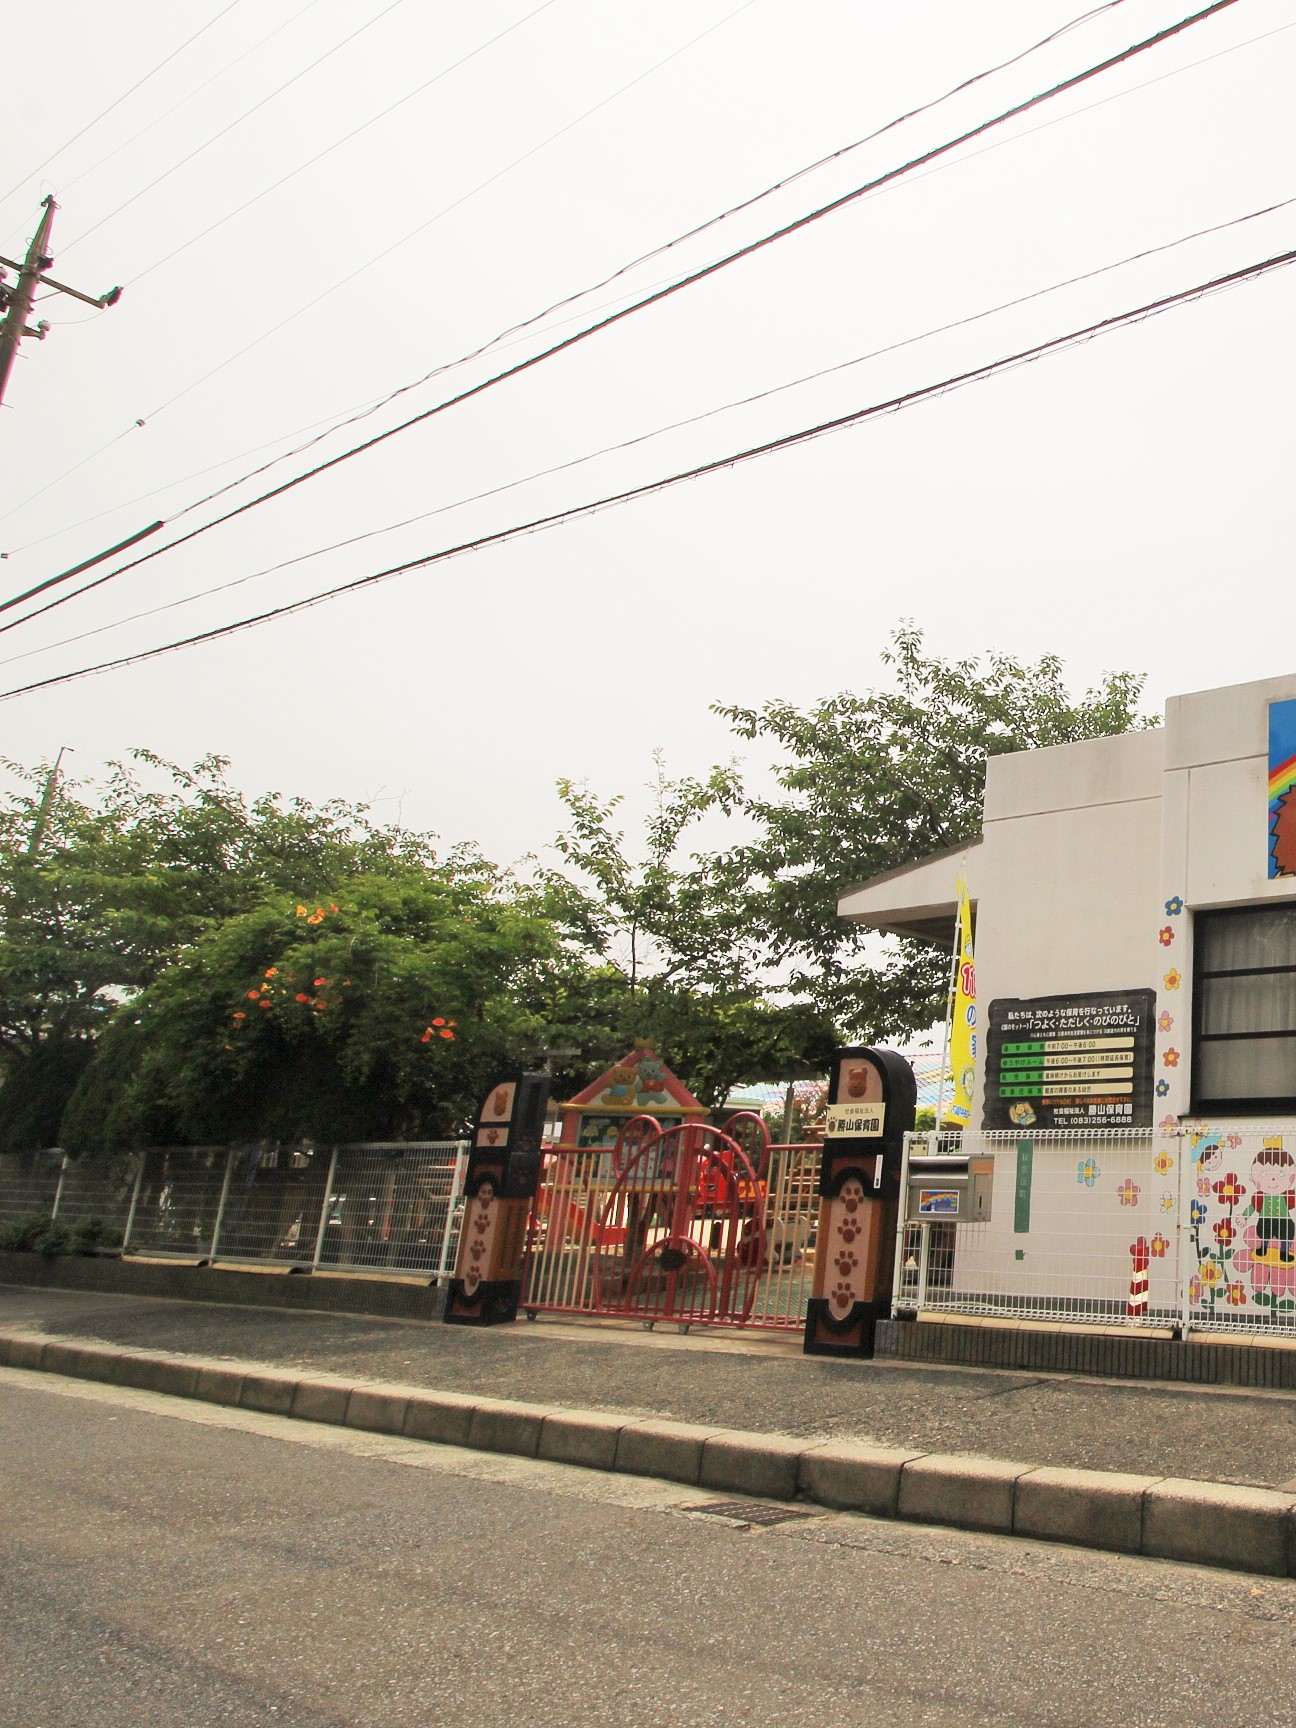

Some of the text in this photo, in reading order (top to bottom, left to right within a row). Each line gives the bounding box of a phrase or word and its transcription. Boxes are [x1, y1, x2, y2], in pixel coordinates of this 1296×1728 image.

[1088, 1103, 1133, 1115] 勝山保育園
[837, 1118, 880, 1132] 勝山保育園
[1053, 1115, 1132, 1125] TEL (083)256-6888
